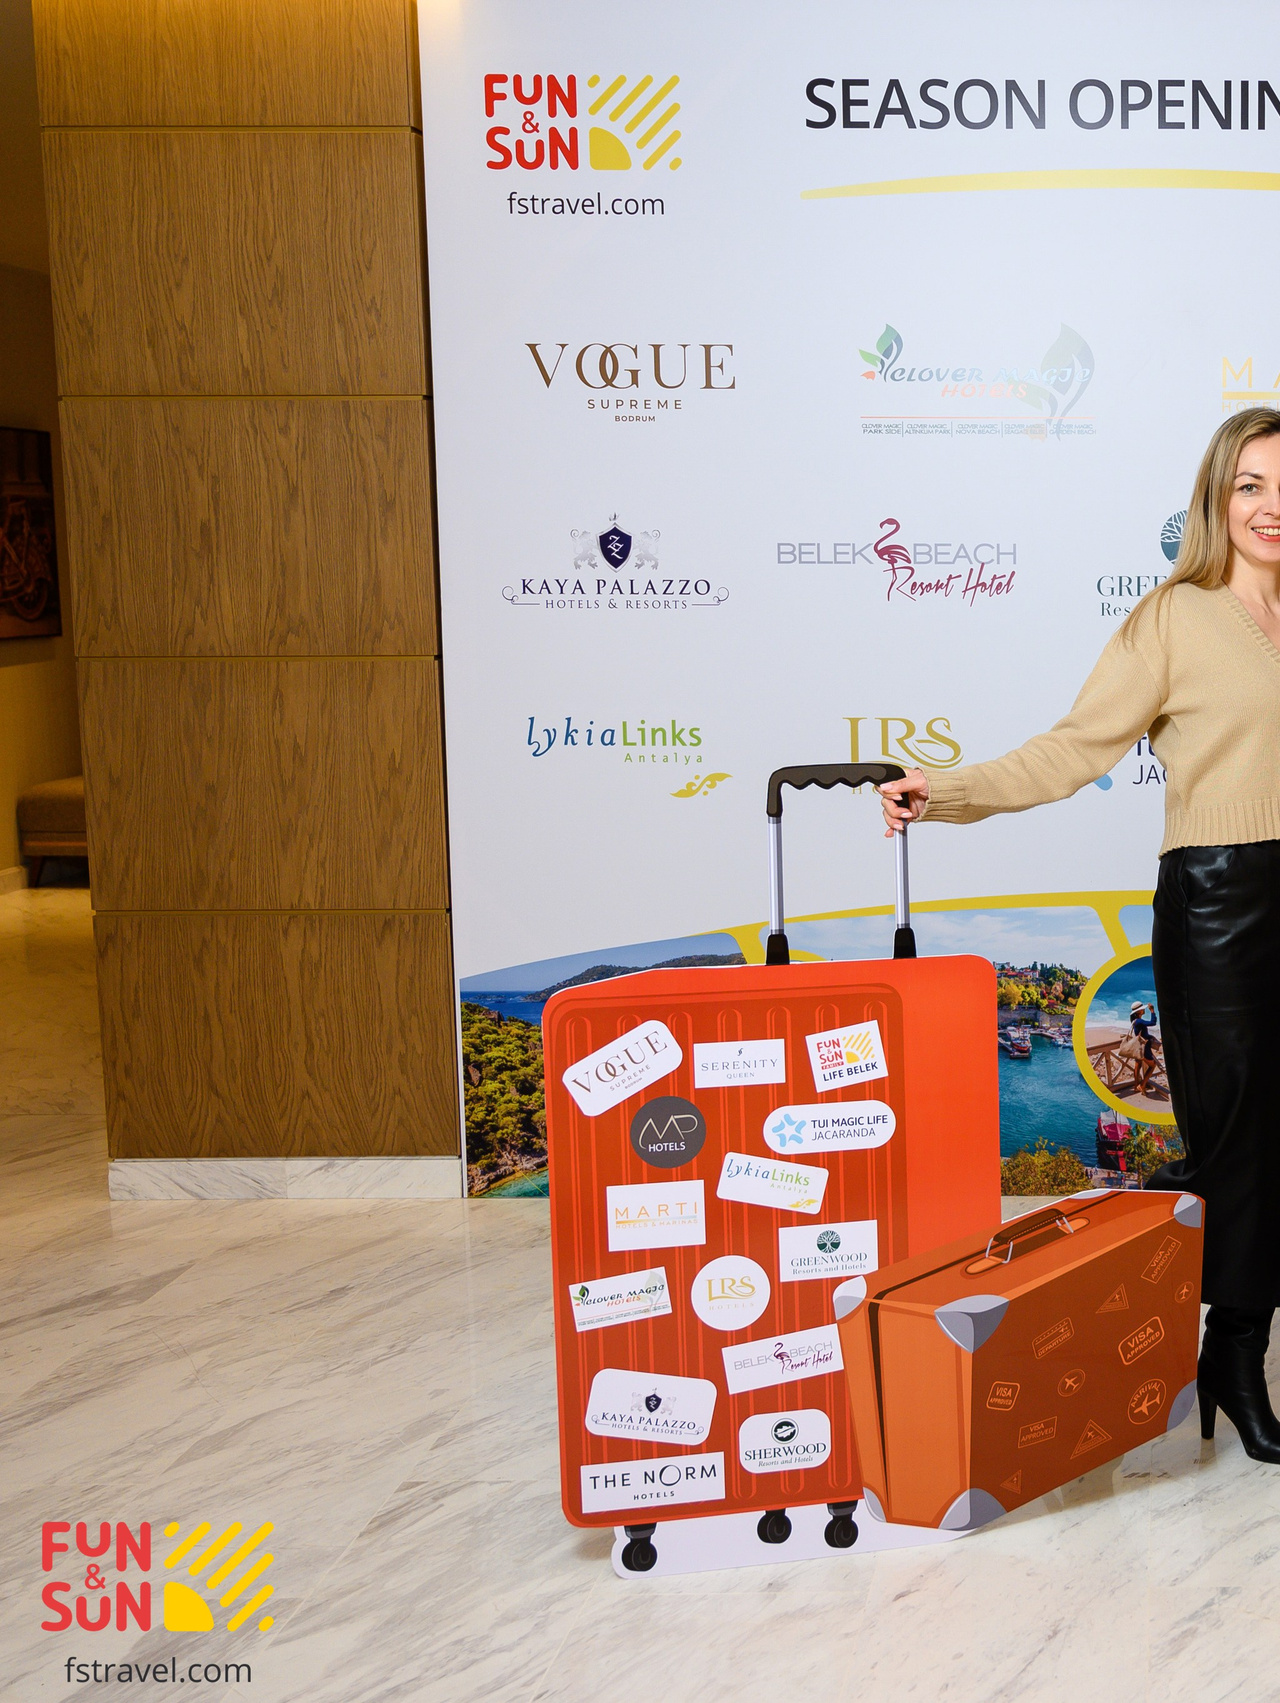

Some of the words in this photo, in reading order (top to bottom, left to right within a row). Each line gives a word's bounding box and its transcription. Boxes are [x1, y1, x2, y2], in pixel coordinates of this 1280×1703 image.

[484, 74, 578, 119] FUN
[805, 78, 1046, 130] SEASON
[521, 110, 540, 134] &
[485, 127, 579, 170] SUN
[507, 192, 665, 215] fstravel.com
[525, 342, 737, 390] VOGUE
[890, 367, 984, 382] CLOVER
[993, 367, 1091, 384] MAGIC
[941, 383, 1028, 398] HOTELS
[588, 399, 683, 410] SUPREME
[777, 543, 874, 565] BELEK
[913, 543, 1017, 565] BEACH
[521, 578, 587, 596] KAYA
[596, 578, 711, 596] PALAZZO
[884, 565, 962, 602] Resort
[962, 562, 1016, 607] Hotel
[545, 599, 604, 610] HOTELS
[608, 599, 619, 610] &
[625, 600, 688, 610] RESORTS
[624, 752, 703, 766] Antalya
[817, 1038, 841, 1052] FUN
[572, 1030, 668, 1094] VOGUE
[701, 1059, 778, 1072] SERENITY
[819, 1050, 843, 1064] SUN
[609, 1064, 651, 1092] SUPREME
[823, 1070, 844, 1082] LIFE
[846, 1062, 878, 1076] BELEK
[811, 1118, 830, 1130] TUI
[831, 1117, 865, 1128] MAGIC
[867, 1114, 888, 1126] LIFE
[812, 1128, 876, 1142] JACARANDA
[648, 1142, 686, 1152] HOTELS
[770, 1183, 808, 1194] Antalya
[615, 1202, 698, 1220] MARTI
[790, 1252, 868, 1268] GREENWOOD
[1150, 1250, 1165, 1267] VISA
[1150, 1242, 1176, 1280] APPROVED
[792, 1267, 822, 1276] Resorts
[824, 1265, 839, 1273] and
[841, 1262, 866, 1272] Hotels
[586, 1293, 622, 1305] CLOVER
[626, 1284, 664, 1297] MAGIC
[707, 1276, 756, 1302] LRS
[607, 1294, 641, 1307] HOTELS
[708, 1302, 755, 1311] HOTELS
[1038, 1332, 1072, 1356] DEPARTURE
[1126, 1331, 1160, 1360] APPROVED
[1128, 1326, 1154, 1348] VISA
[734, 1354, 774, 1370] BELEK
[790, 1341, 832, 1358] BEACH
[812, 1351, 833, 1369] Hotel
[996, 1386, 1012, 1398] VISA
[1130, 1383, 1161, 1408] ARRIVAL
[601, 1412, 634, 1424] KAYA
[638, 1416, 696, 1430] PALAZZO
[612, 1422, 640, 1432] HOTELS
[651, 1427, 683, 1436] RESORTS
[1030, 1423, 1044, 1432] VISA
[1021, 1427, 1054, 1442] APPROVED
[744, 1442, 826, 1462] SHERWOOD
[758, 1458, 780, 1468] Resorts
[781, 1456, 794, 1466] and
[796, 1455, 814, 1464] Hotels
[589, 1473, 632, 1490] THE
[643, 1464, 718, 1486] NORM
[634, 1490, 675, 1501] HOTELS
